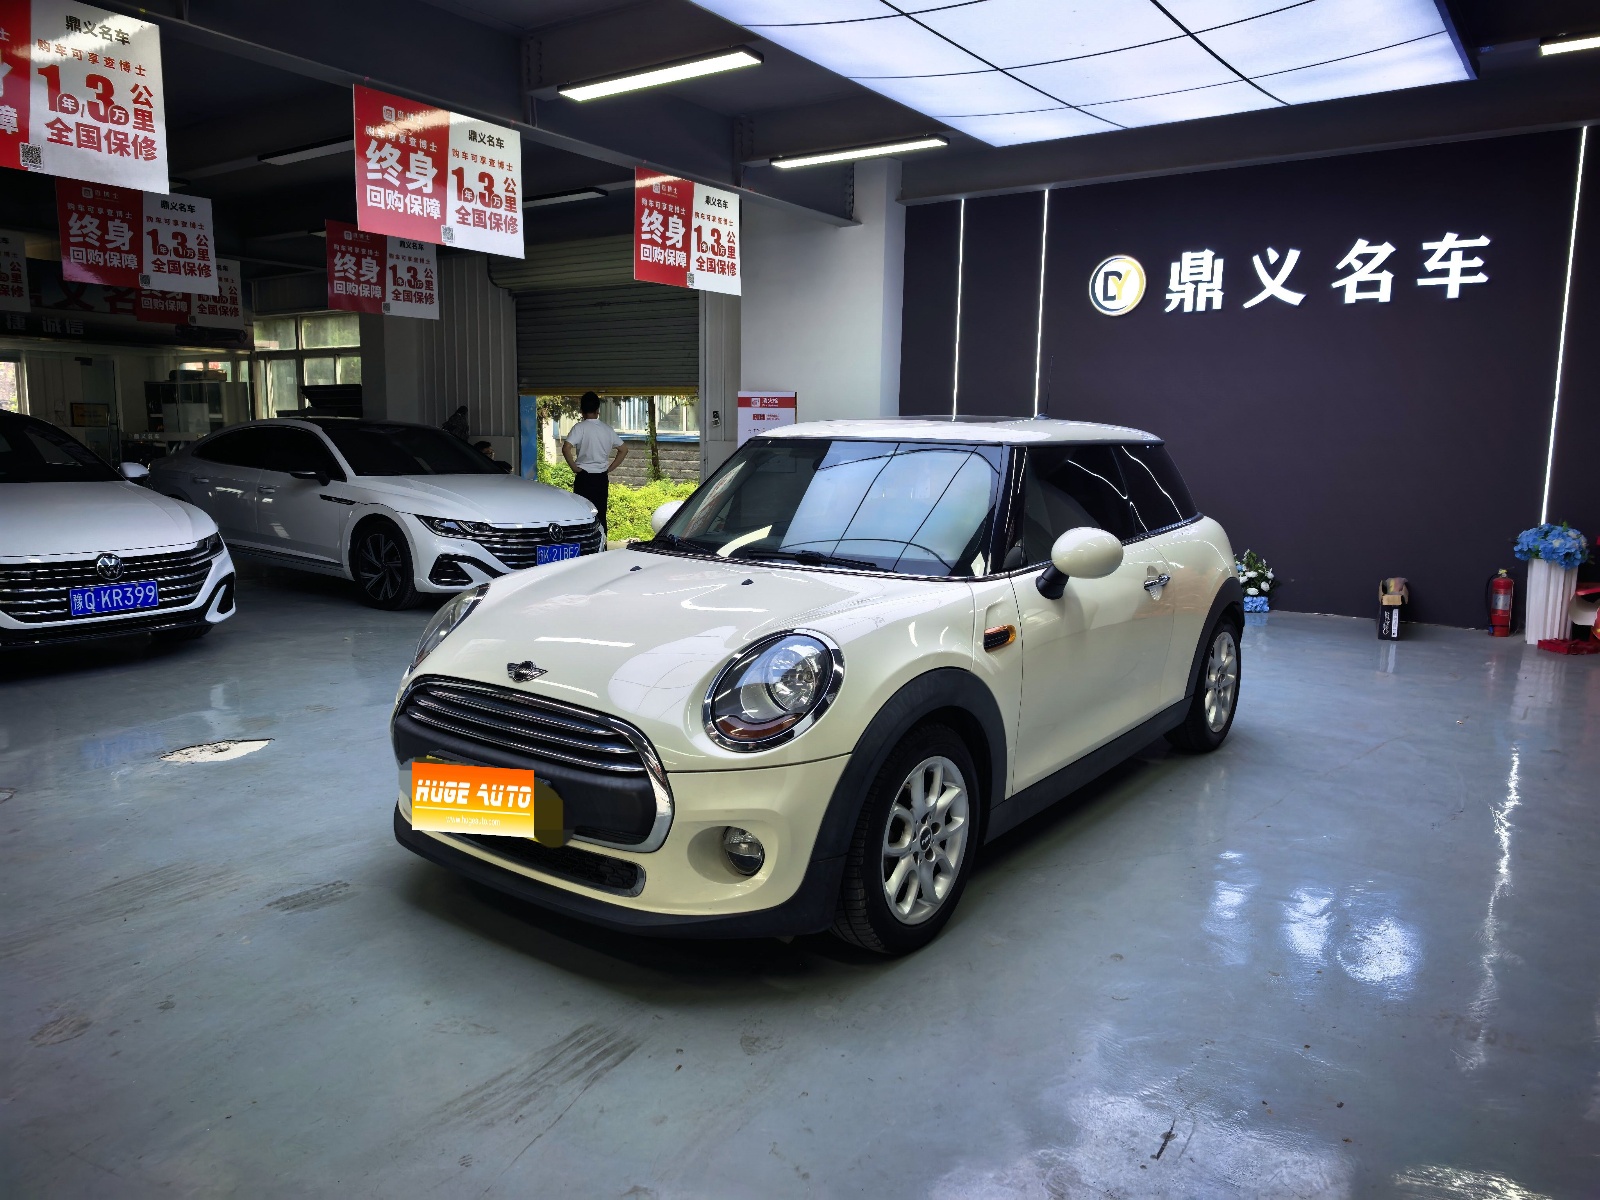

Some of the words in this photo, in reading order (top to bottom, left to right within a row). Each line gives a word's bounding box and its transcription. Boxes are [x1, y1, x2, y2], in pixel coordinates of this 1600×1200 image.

[65, 15, 131, 46] 鼎义名车
[37, 38, 147, 77] 购车可享查博士
[45, 117, 158, 162] 全国保修
[468, 129, 505, 150] 鼎义名车
[366, 140, 438, 194] 终身
[452, 149, 513, 172] 购车可享查博士
[160, 199, 196, 214] 鼎义名车
[366, 185, 441, 220] 回购保障
[455, 205, 519, 234] 全国保修
[640, 208, 686, 249] 终身
[68, 213, 134, 251] 终身
[70, 246, 138, 270] 回购保障
[641, 243, 687, 268] 回购保障
[696, 255, 737, 277] 全国保修
[152, 258, 212, 278] 全国保修
[334, 252, 380, 284] 终身
[1164, 231, 1491, 314] 鼎义名车
[334, 280, 382, 299] 回购保障
[392, 288, 434, 306] 全国保修
[141, 297, 188, 312] 回购保障
[197, 304, 239, 317] 全国保修
[42, 315, 84, 335] 诚信
